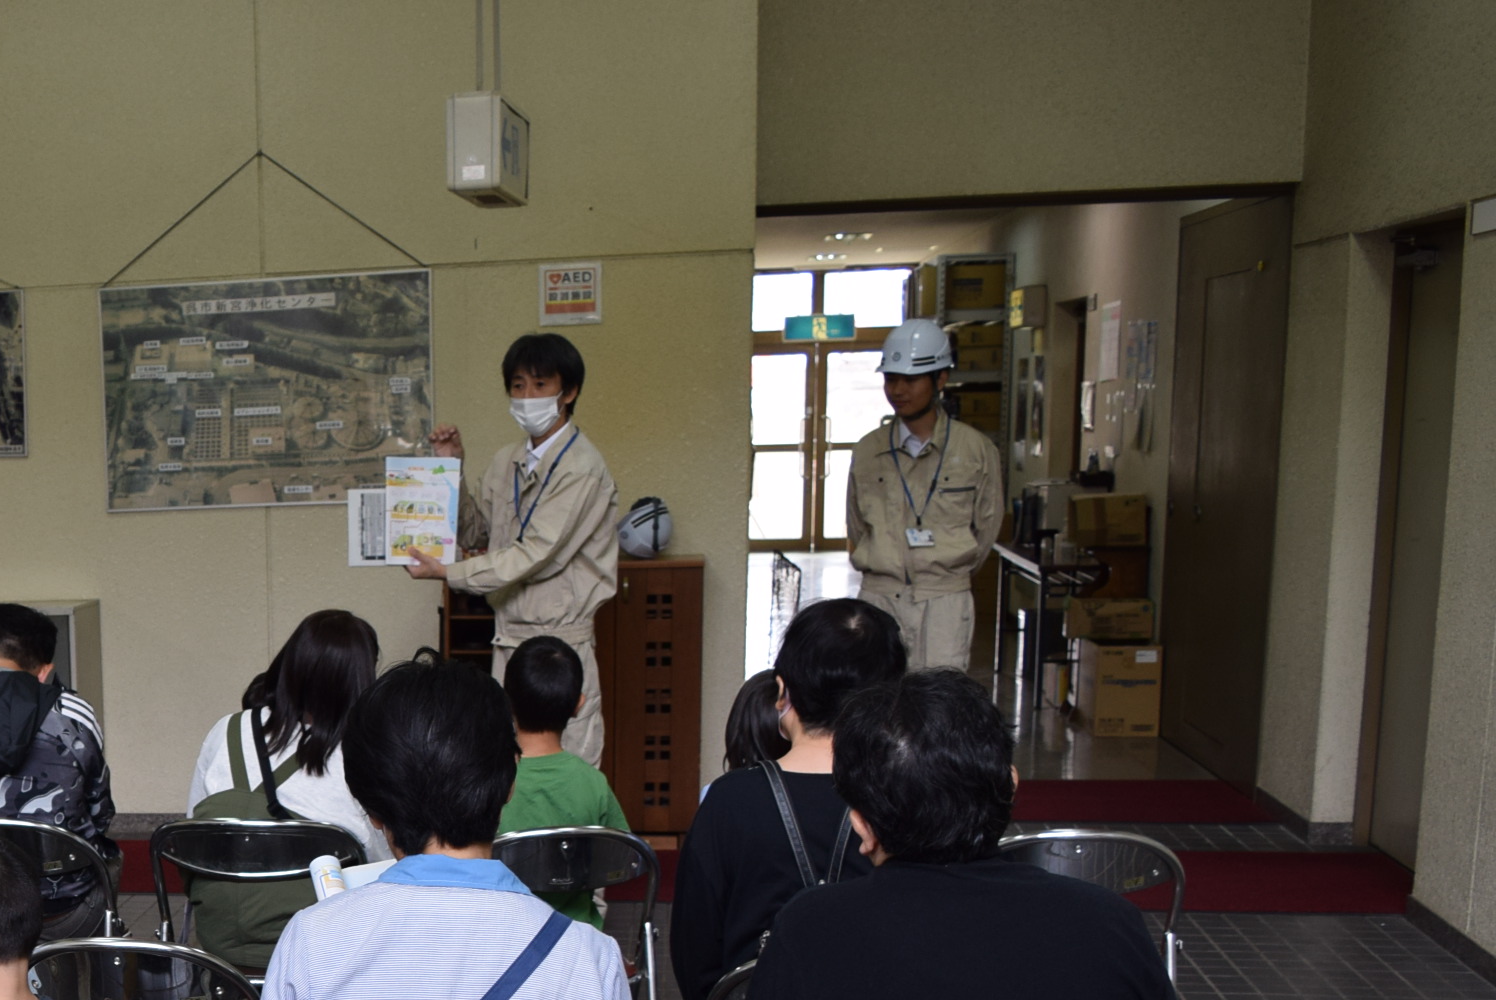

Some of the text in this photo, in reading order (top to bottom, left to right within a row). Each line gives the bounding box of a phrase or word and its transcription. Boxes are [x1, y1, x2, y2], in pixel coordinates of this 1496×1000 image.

[562, 271, 593, 284] AED
[185, 296, 329, 313] 呉市新宮浄化センター
